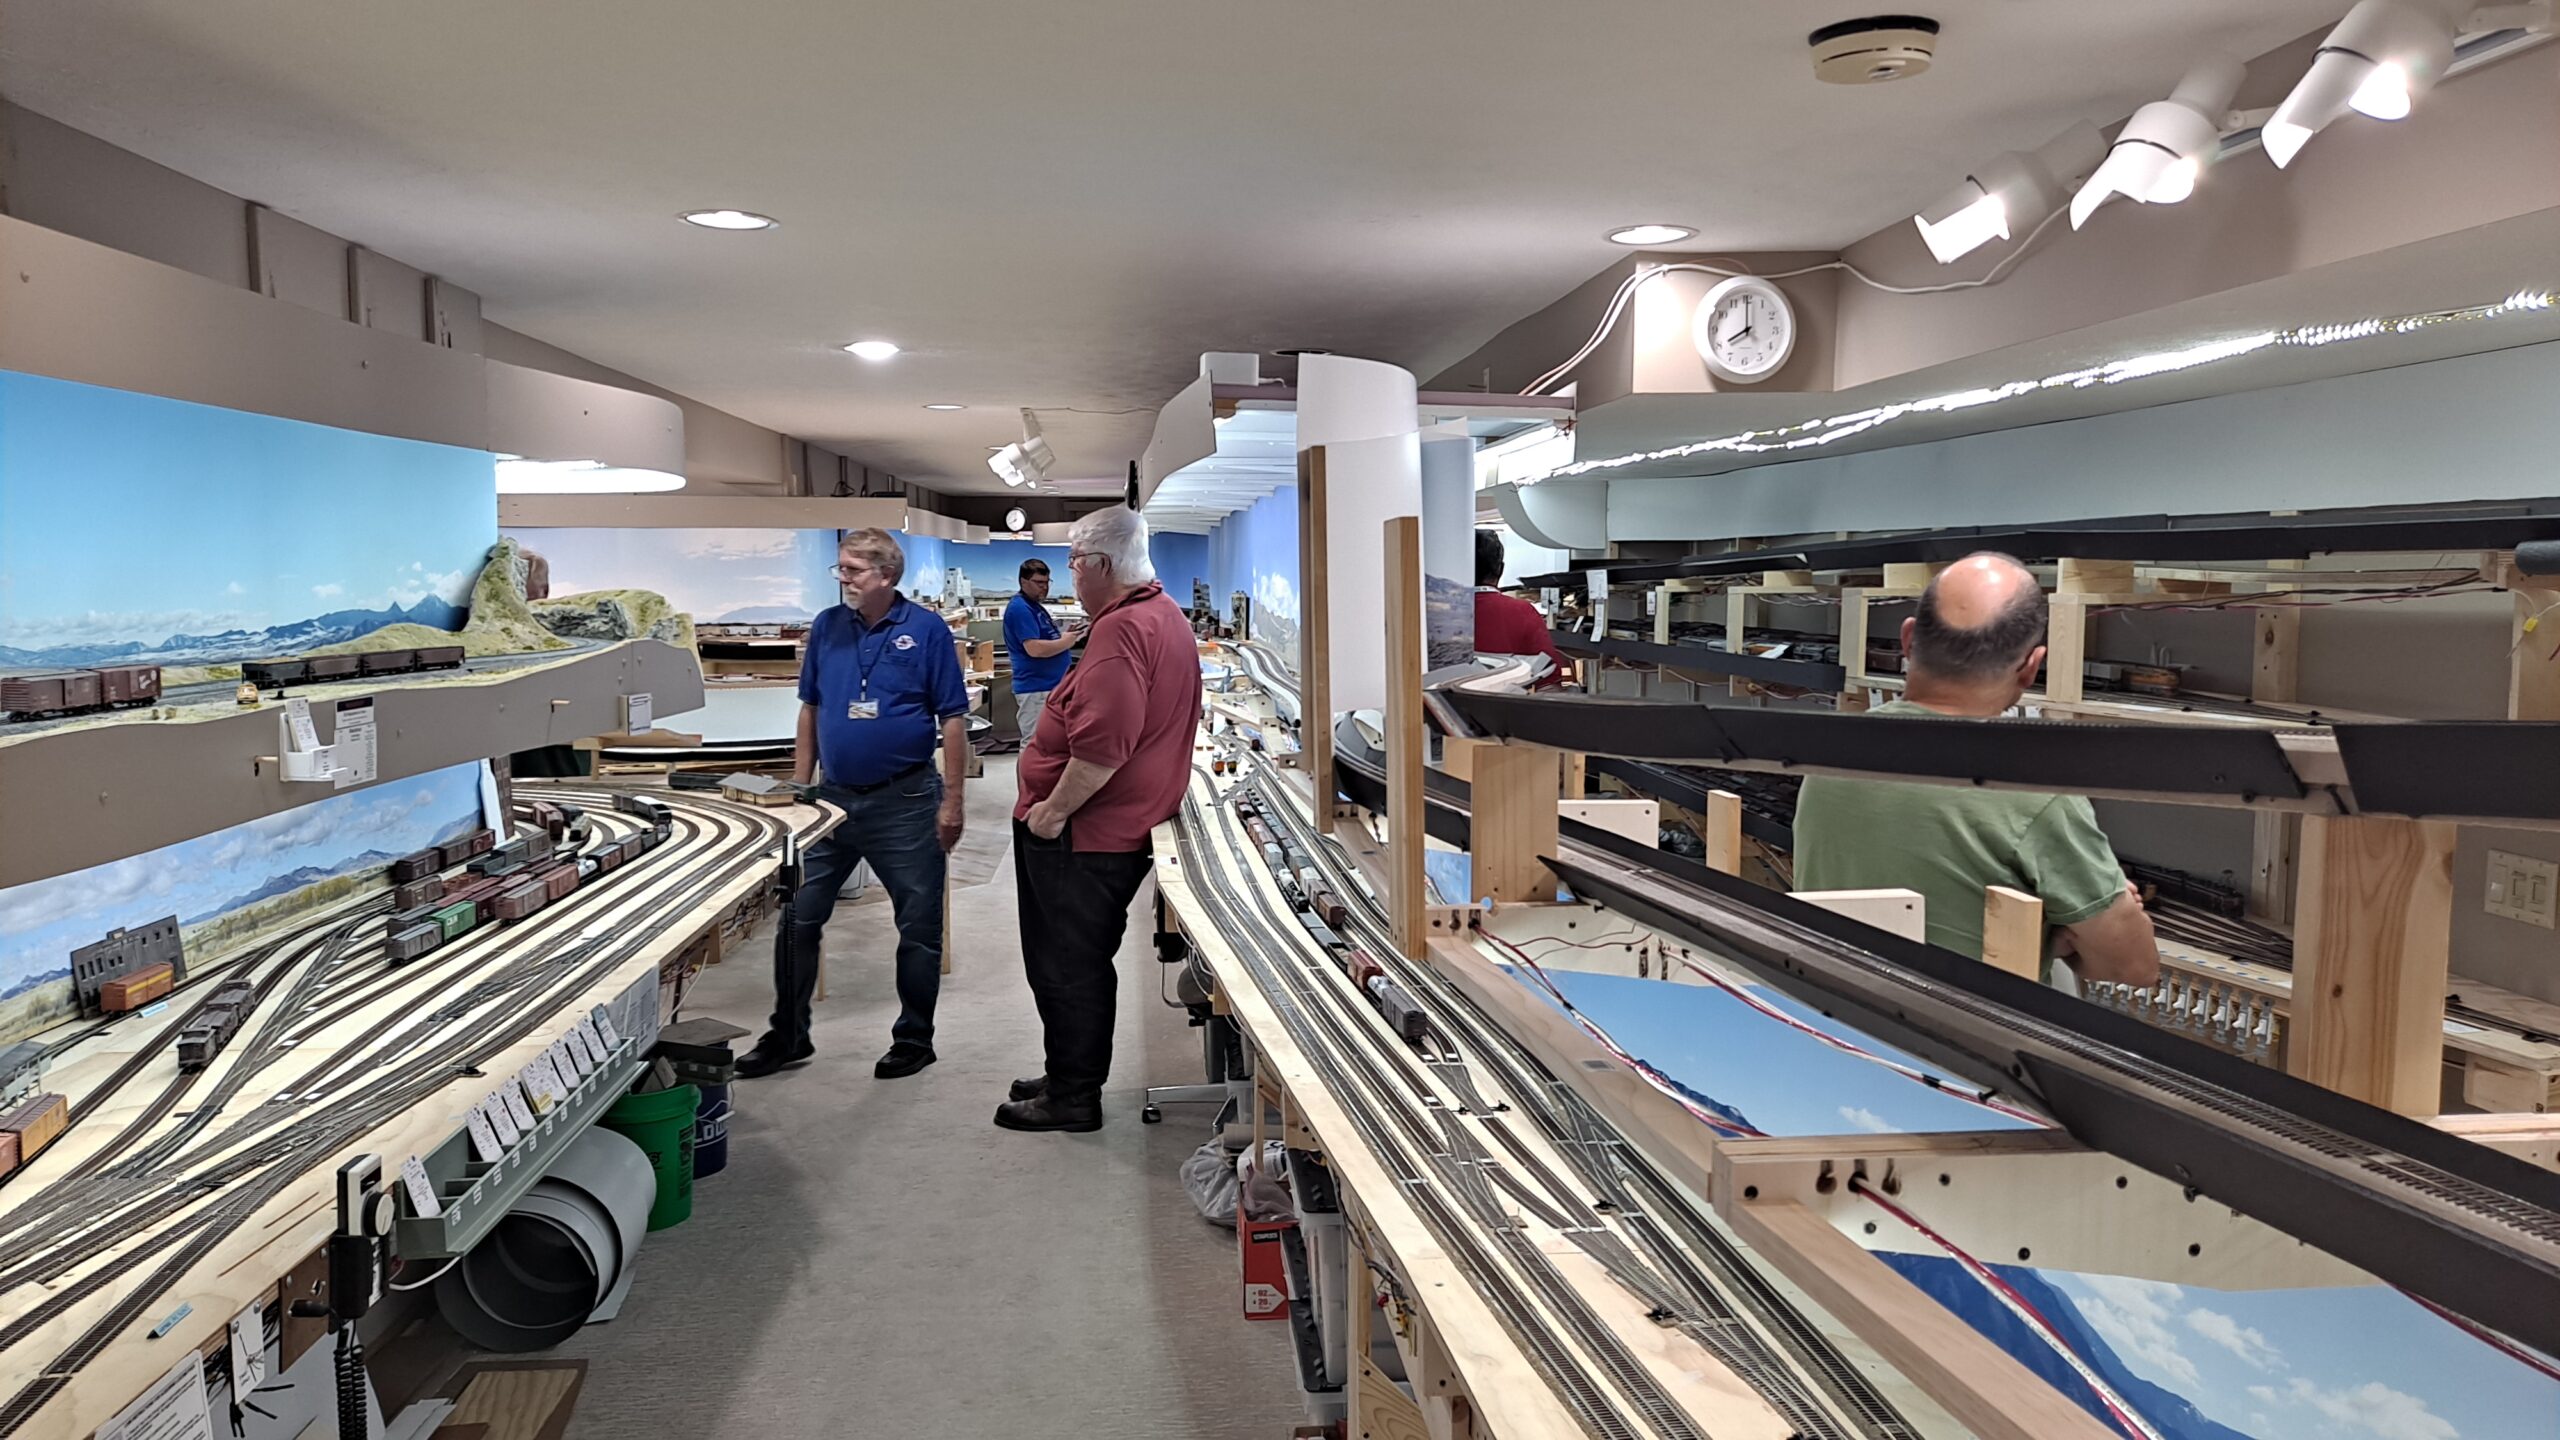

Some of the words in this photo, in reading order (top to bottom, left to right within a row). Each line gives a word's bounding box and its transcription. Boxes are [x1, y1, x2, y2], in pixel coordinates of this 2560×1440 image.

[1730, 299, 1738, 309] 11
[1768, 311, 1776, 321] 2
[1712, 325, 1718, 335] 9
[1772, 326, 1780, 335] 3
[1741, 357, 1749, 366] 6
